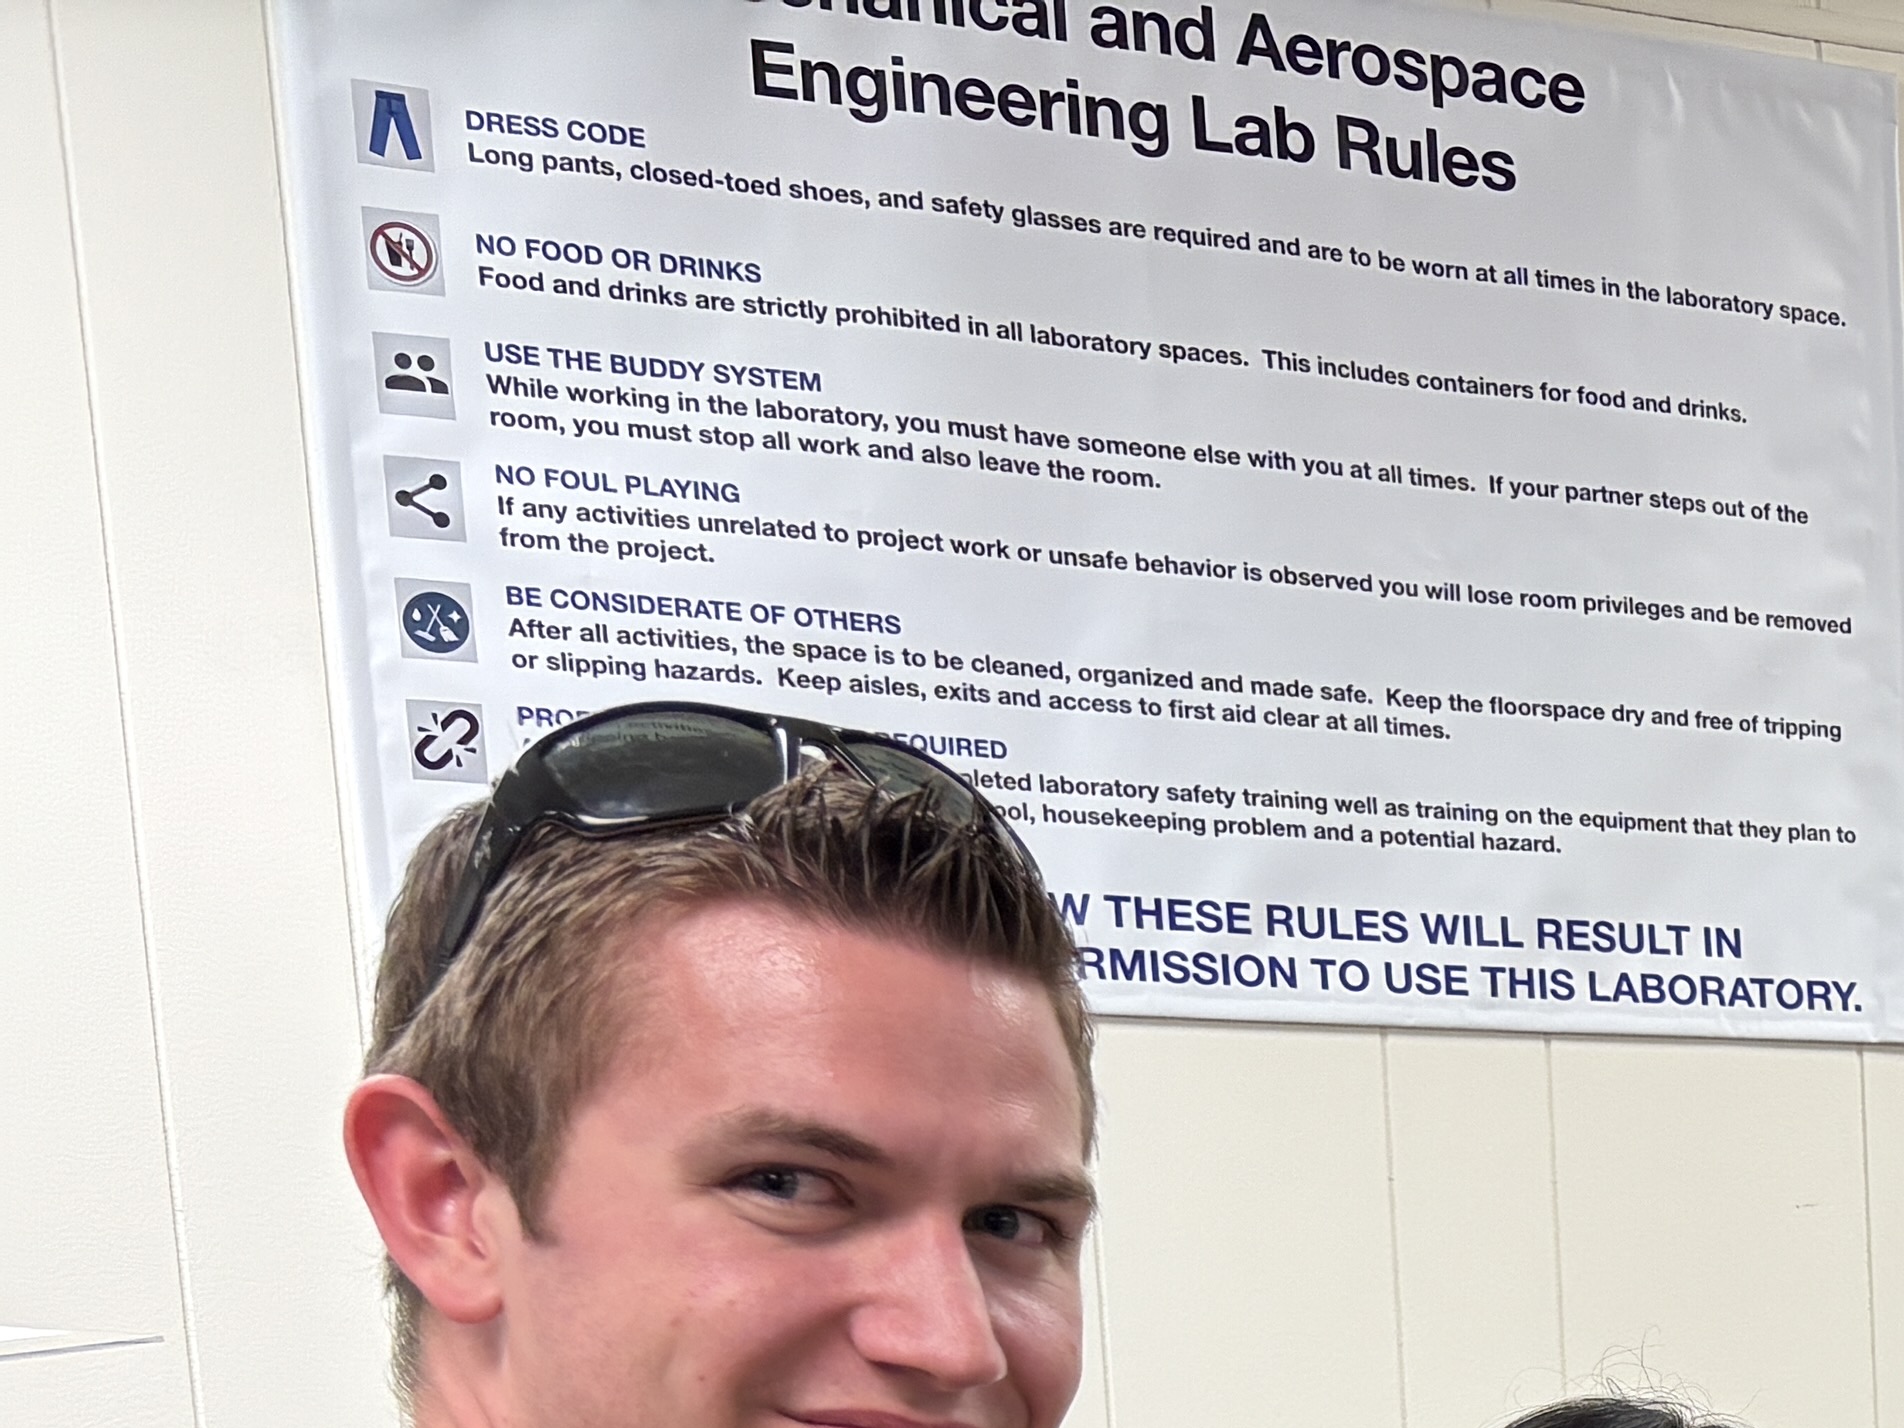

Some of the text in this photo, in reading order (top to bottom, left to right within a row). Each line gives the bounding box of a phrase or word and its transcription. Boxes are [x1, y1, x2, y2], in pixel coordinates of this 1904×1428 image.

[1090, 3, 1216, 62] and
[1236, 12, 1586, 114] Aerospace
[465, 109, 647, 149] DRESS CODE
[749, 38, 1517, 192] Engineering Lab Rules
[467, 141, 1847, 328] Long pants, closed-toed shoes, and safety glasses are required and are to be worn at all times in the laboratory space.
[475, 232, 762, 284] NO FOOD OR DRINKS
[483, 340, 822, 393] USE THE BUDDY SYSTEM
[494, 463, 741, 504] NO FOUL PLAYING
[498, 526, 716, 564] from the project.
[505, 585, 902, 636] BE CONSIDERATE OF OTHERS
[511, 651, 1451, 740] or slipping hazards. Keep aisles, exits and access to first aid clear at all times.
[1038, 773, 1160, 805] laboratory
[1165, 783, 1237, 810] safety
[1241, 787, 1328, 816] training
[1333, 795, 1379, 816] well
[1383, 801, 1411, 818] as
[1414, 800, 1499, 827] training
[1504, 809, 1533, 825] on
[1537, 806, 1574, 827] the
[1578, 810, 1688, 835] equipment
[1691, 816, 1734, 838] that
[1737, 819, 1783, 844] they
[1787, 822, 1831, 845] plan
[1835, 825, 1857, 844] to
[1102, 894, 1253, 936] THESE
[1265, 903, 1410, 944] RULES
[1419, 912, 1525, 949] WILL
[1536, 917, 1691, 957] RESULT
[1702, 925, 1743, 960] IN
[1077, 946, 1863, 1013] RMISSION TO USE THIS LABORATORY.
